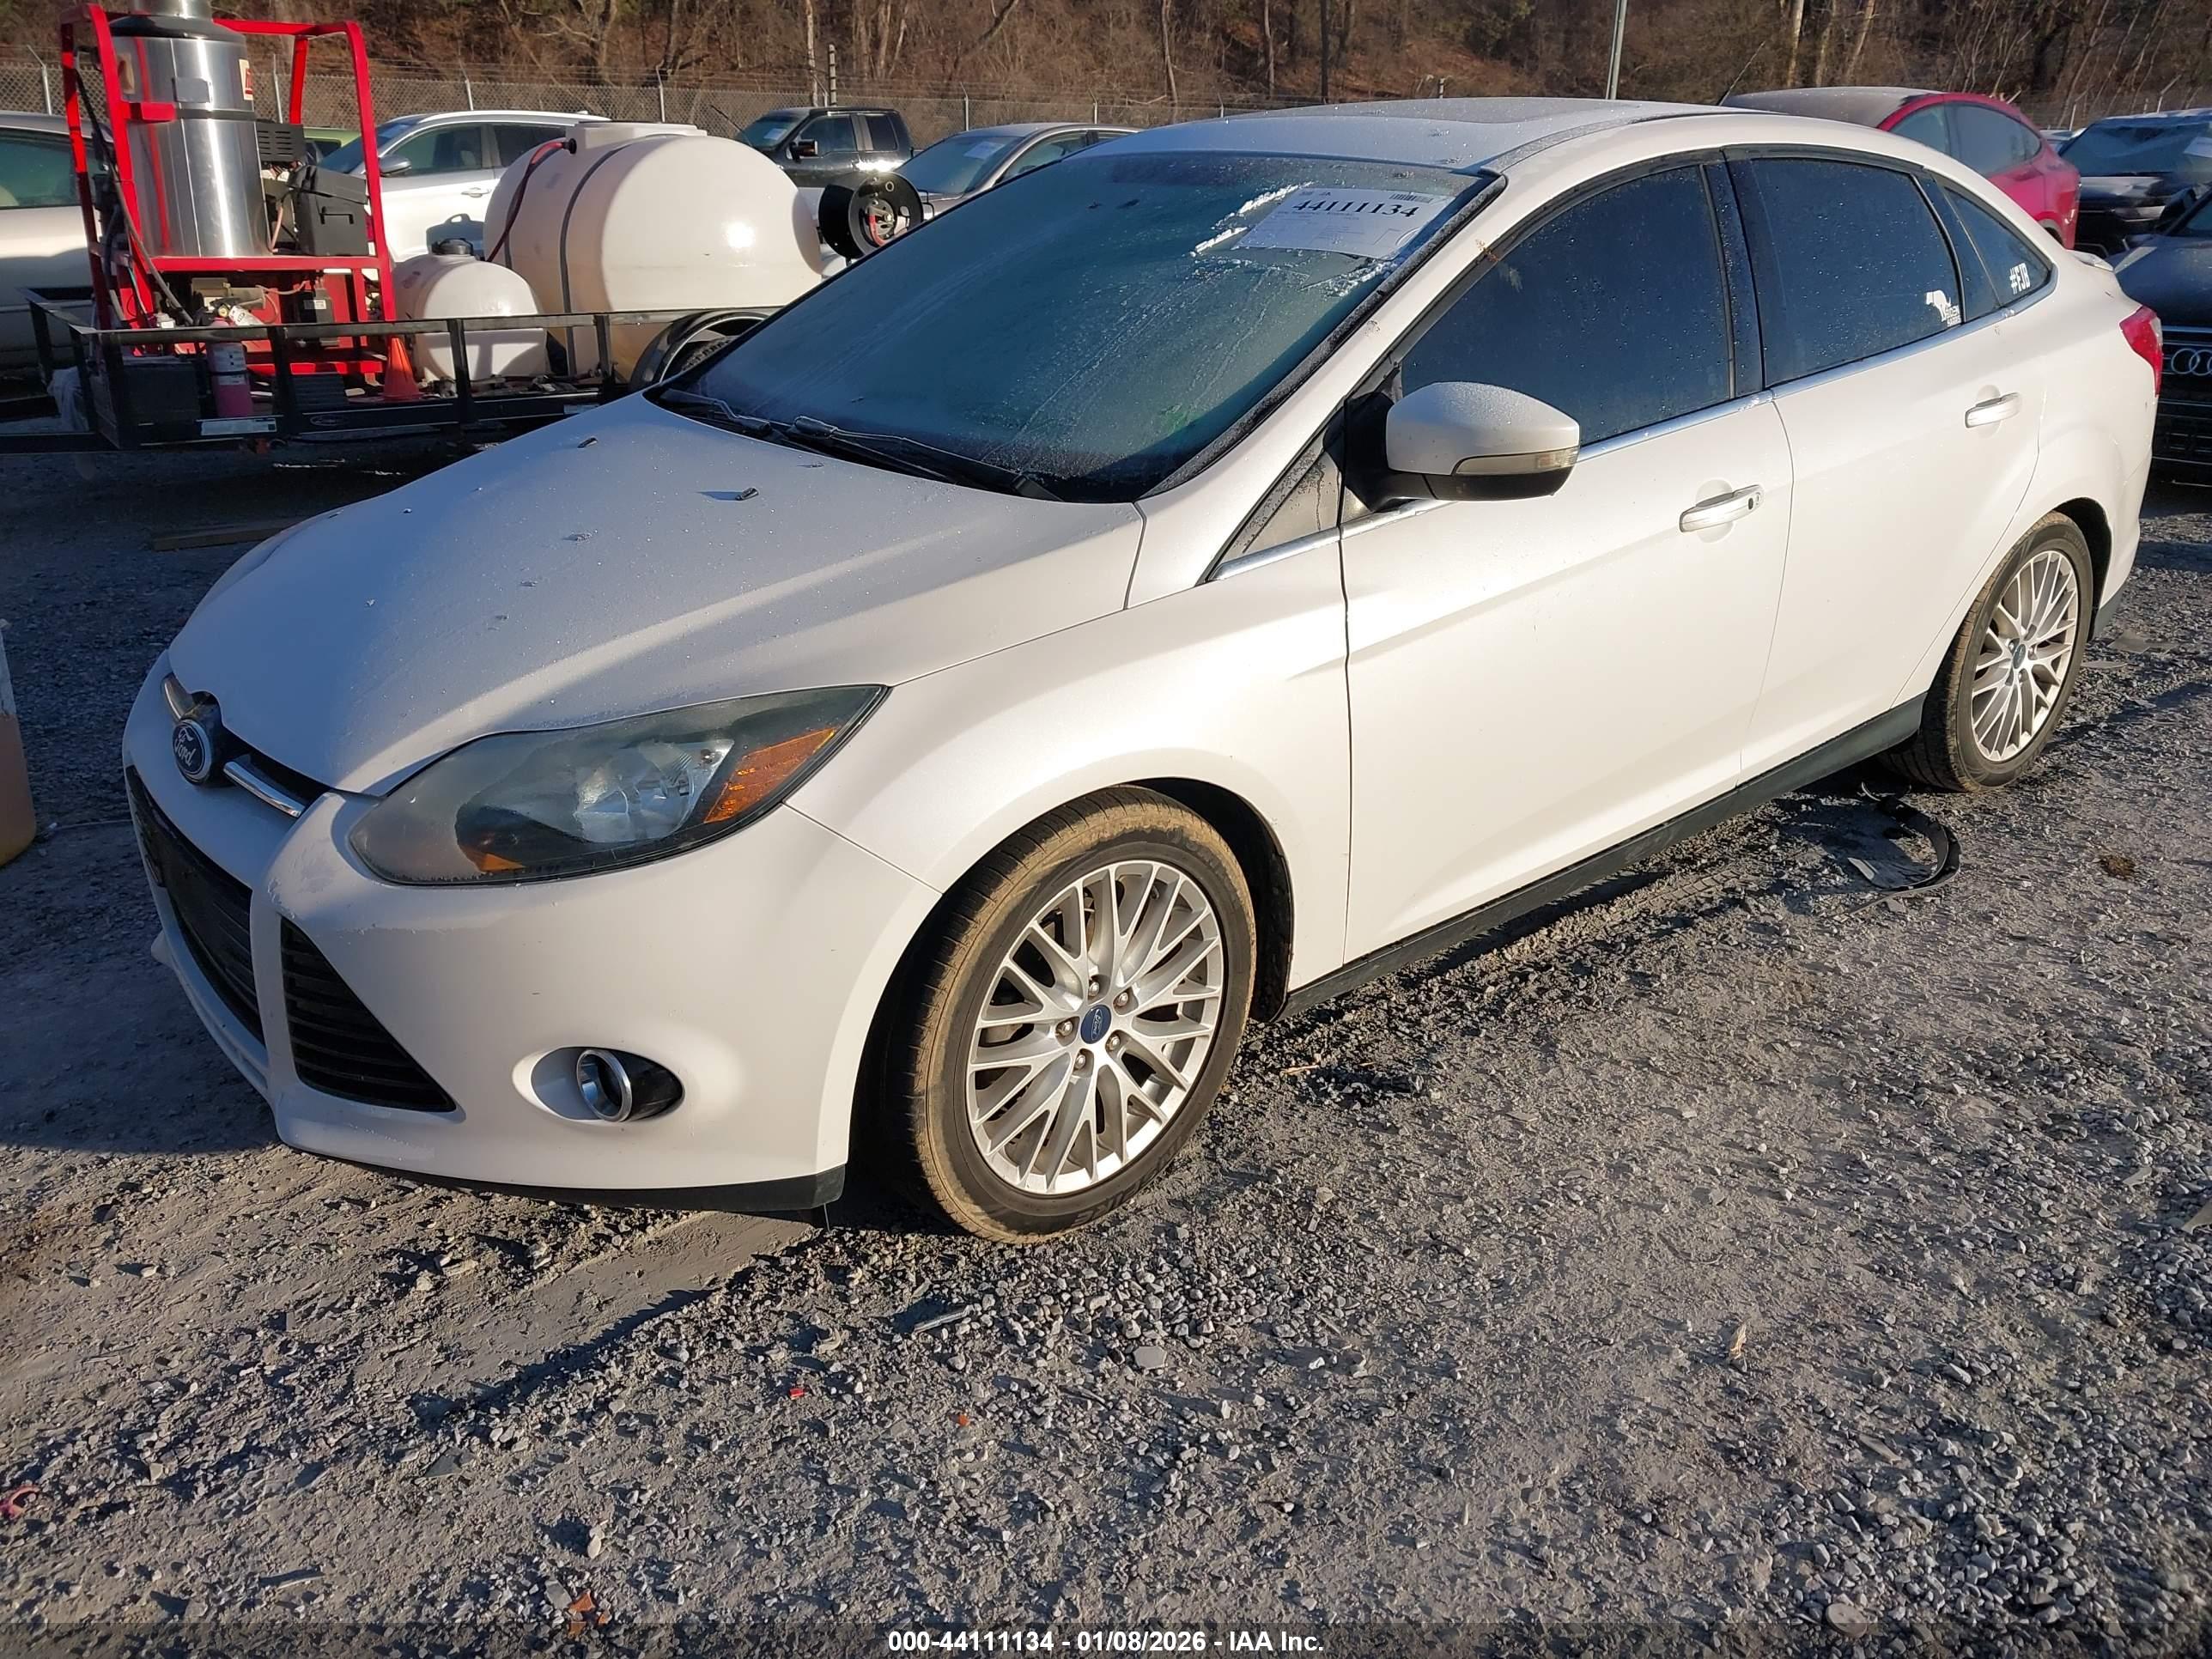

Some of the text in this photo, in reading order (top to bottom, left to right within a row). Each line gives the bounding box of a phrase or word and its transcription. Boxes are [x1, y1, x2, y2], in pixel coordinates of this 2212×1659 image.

[1292, 199, 1420, 217] 44111134
[2009, 262, 2030, 295] #FJB
[174, 727, 197, 767] Ford
